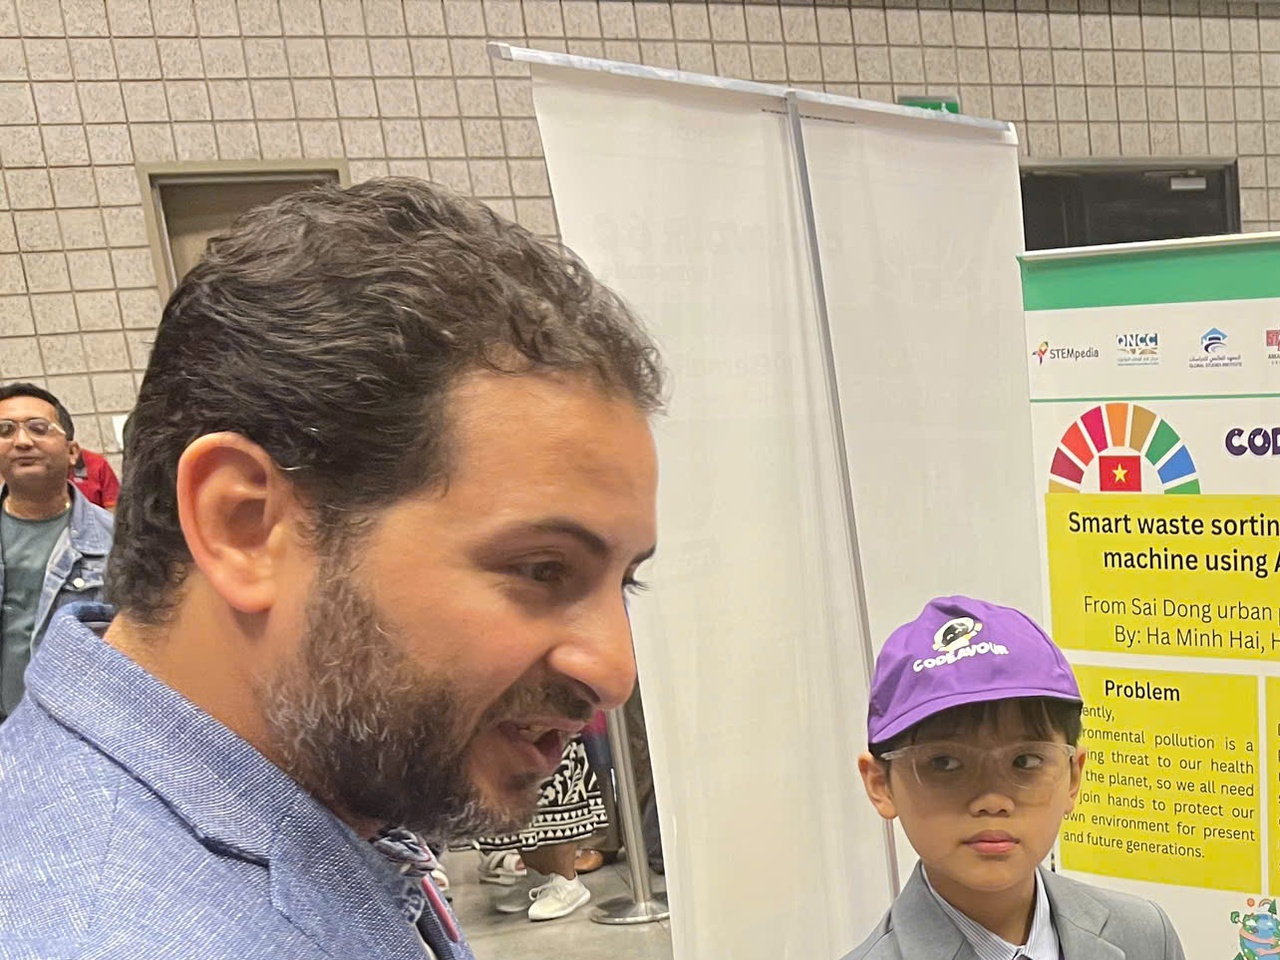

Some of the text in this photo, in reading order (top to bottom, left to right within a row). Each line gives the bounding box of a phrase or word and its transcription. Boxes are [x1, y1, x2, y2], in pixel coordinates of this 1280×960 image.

[1049, 348, 1099, 361] STEMpedia
[1068, 512, 1132, 533] Smart
[1137, 515, 1204, 535] waste
[1103, 547, 1198, 570] machine
[1205, 549, 1268, 579] using
[1084, 596, 1126, 615] From
[1131, 598, 1157, 616] Sai
[1163, 599, 1212, 623] Dong
[1217, 601, 1272, 621] urban
[1115, 625, 1141, 648] By:
[1147, 627, 1171, 646] Ha
[1177, 628, 1223, 648] Minh
[1230, 630, 1265, 654] Hai,
[913, 642, 1009, 672] CODEAVOUR
[1104, 679, 1180, 702] Problem
[1154, 733, 1215, 750] pollution
[1225, 737, 1236, 751] is
[1246, 741, 1254, 752] a
[1111, 751, 1150, 767] threat
[1157, 755, 1171, 768] to
[1179, 759, 1202, 771] our
[1210, 758, 1254, 775] health
[1085, 770, 1254, 797] the planet, so we all need
[1079, 791, 1255, 819] join hands to protect our
[1091, 813, 1170, 834] environment
[1177, 822, 1197, 836] for
[1203, 825, 1255, 842] present
[1063, 830, 1205, 859] and future generations.
